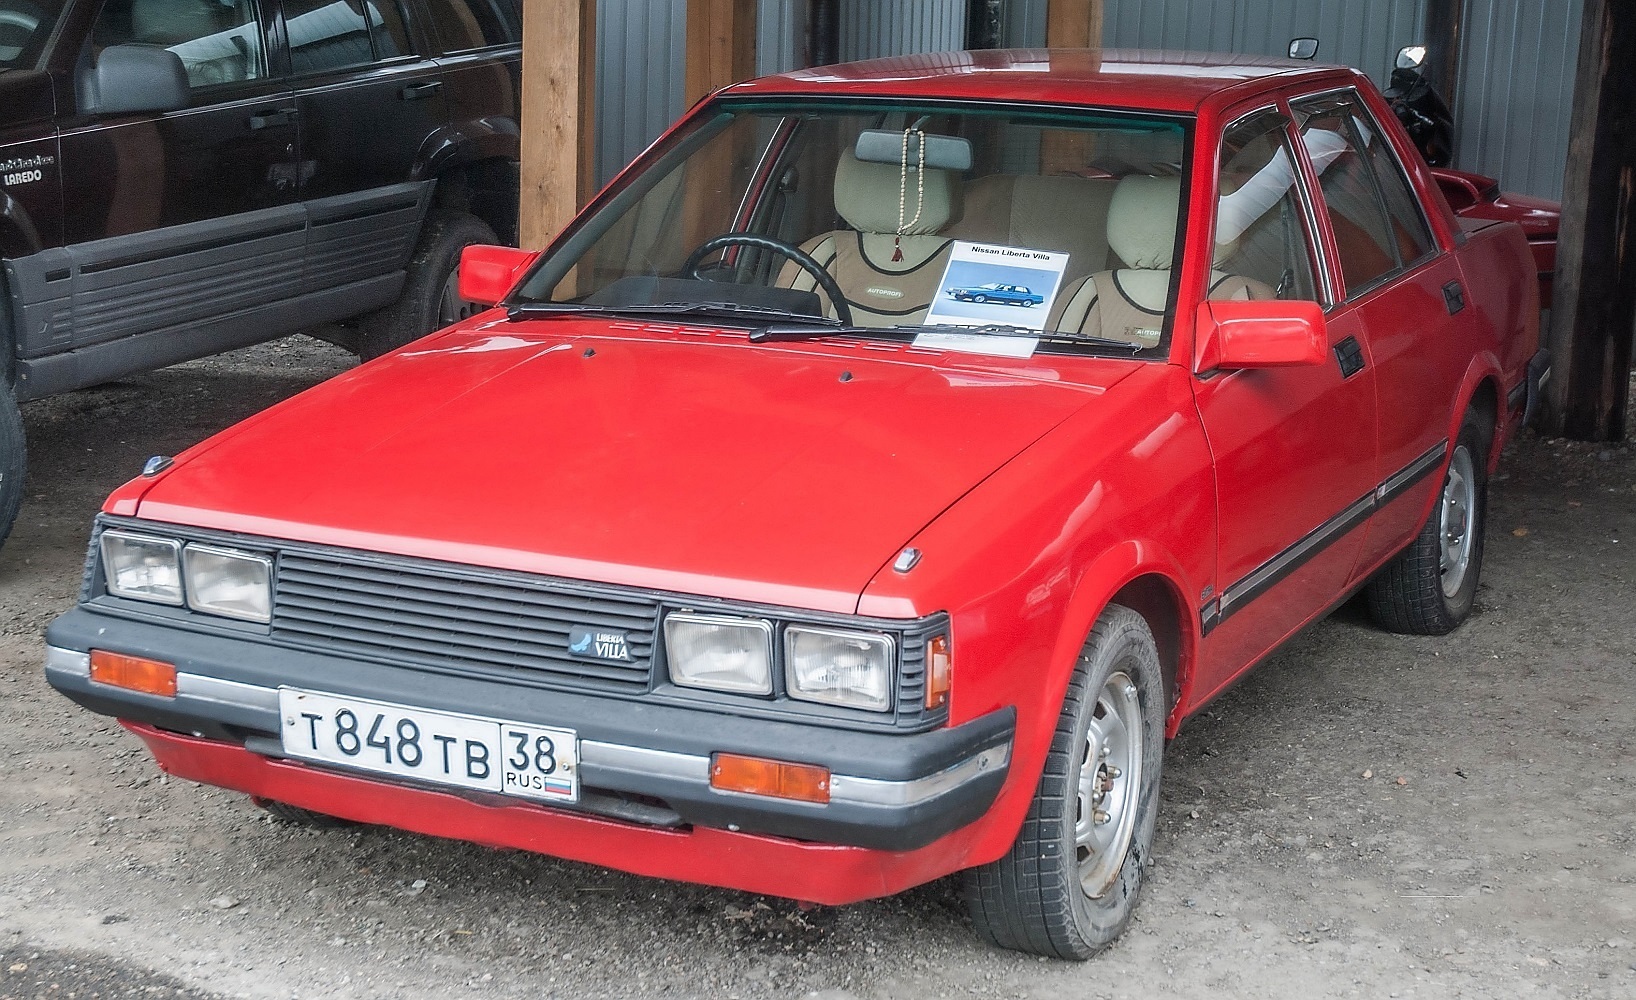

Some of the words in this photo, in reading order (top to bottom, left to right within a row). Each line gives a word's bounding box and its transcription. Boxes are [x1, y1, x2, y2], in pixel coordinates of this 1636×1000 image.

[4, 170, 42, 186] LAREDO
[971, 246, 1000, 255] Nissan
[1001, 250, 1030, 259] Liberta
[1032, 253, 1050, 261] Villa
[867, 288, 902, 297] AUTOPROFI
[596, 632, 625, 645] LIBERTA
[595, 641, 628, 660] VILLA
[508, 731, 556, 775] 38
[506, 772, 542, 790] RUS
